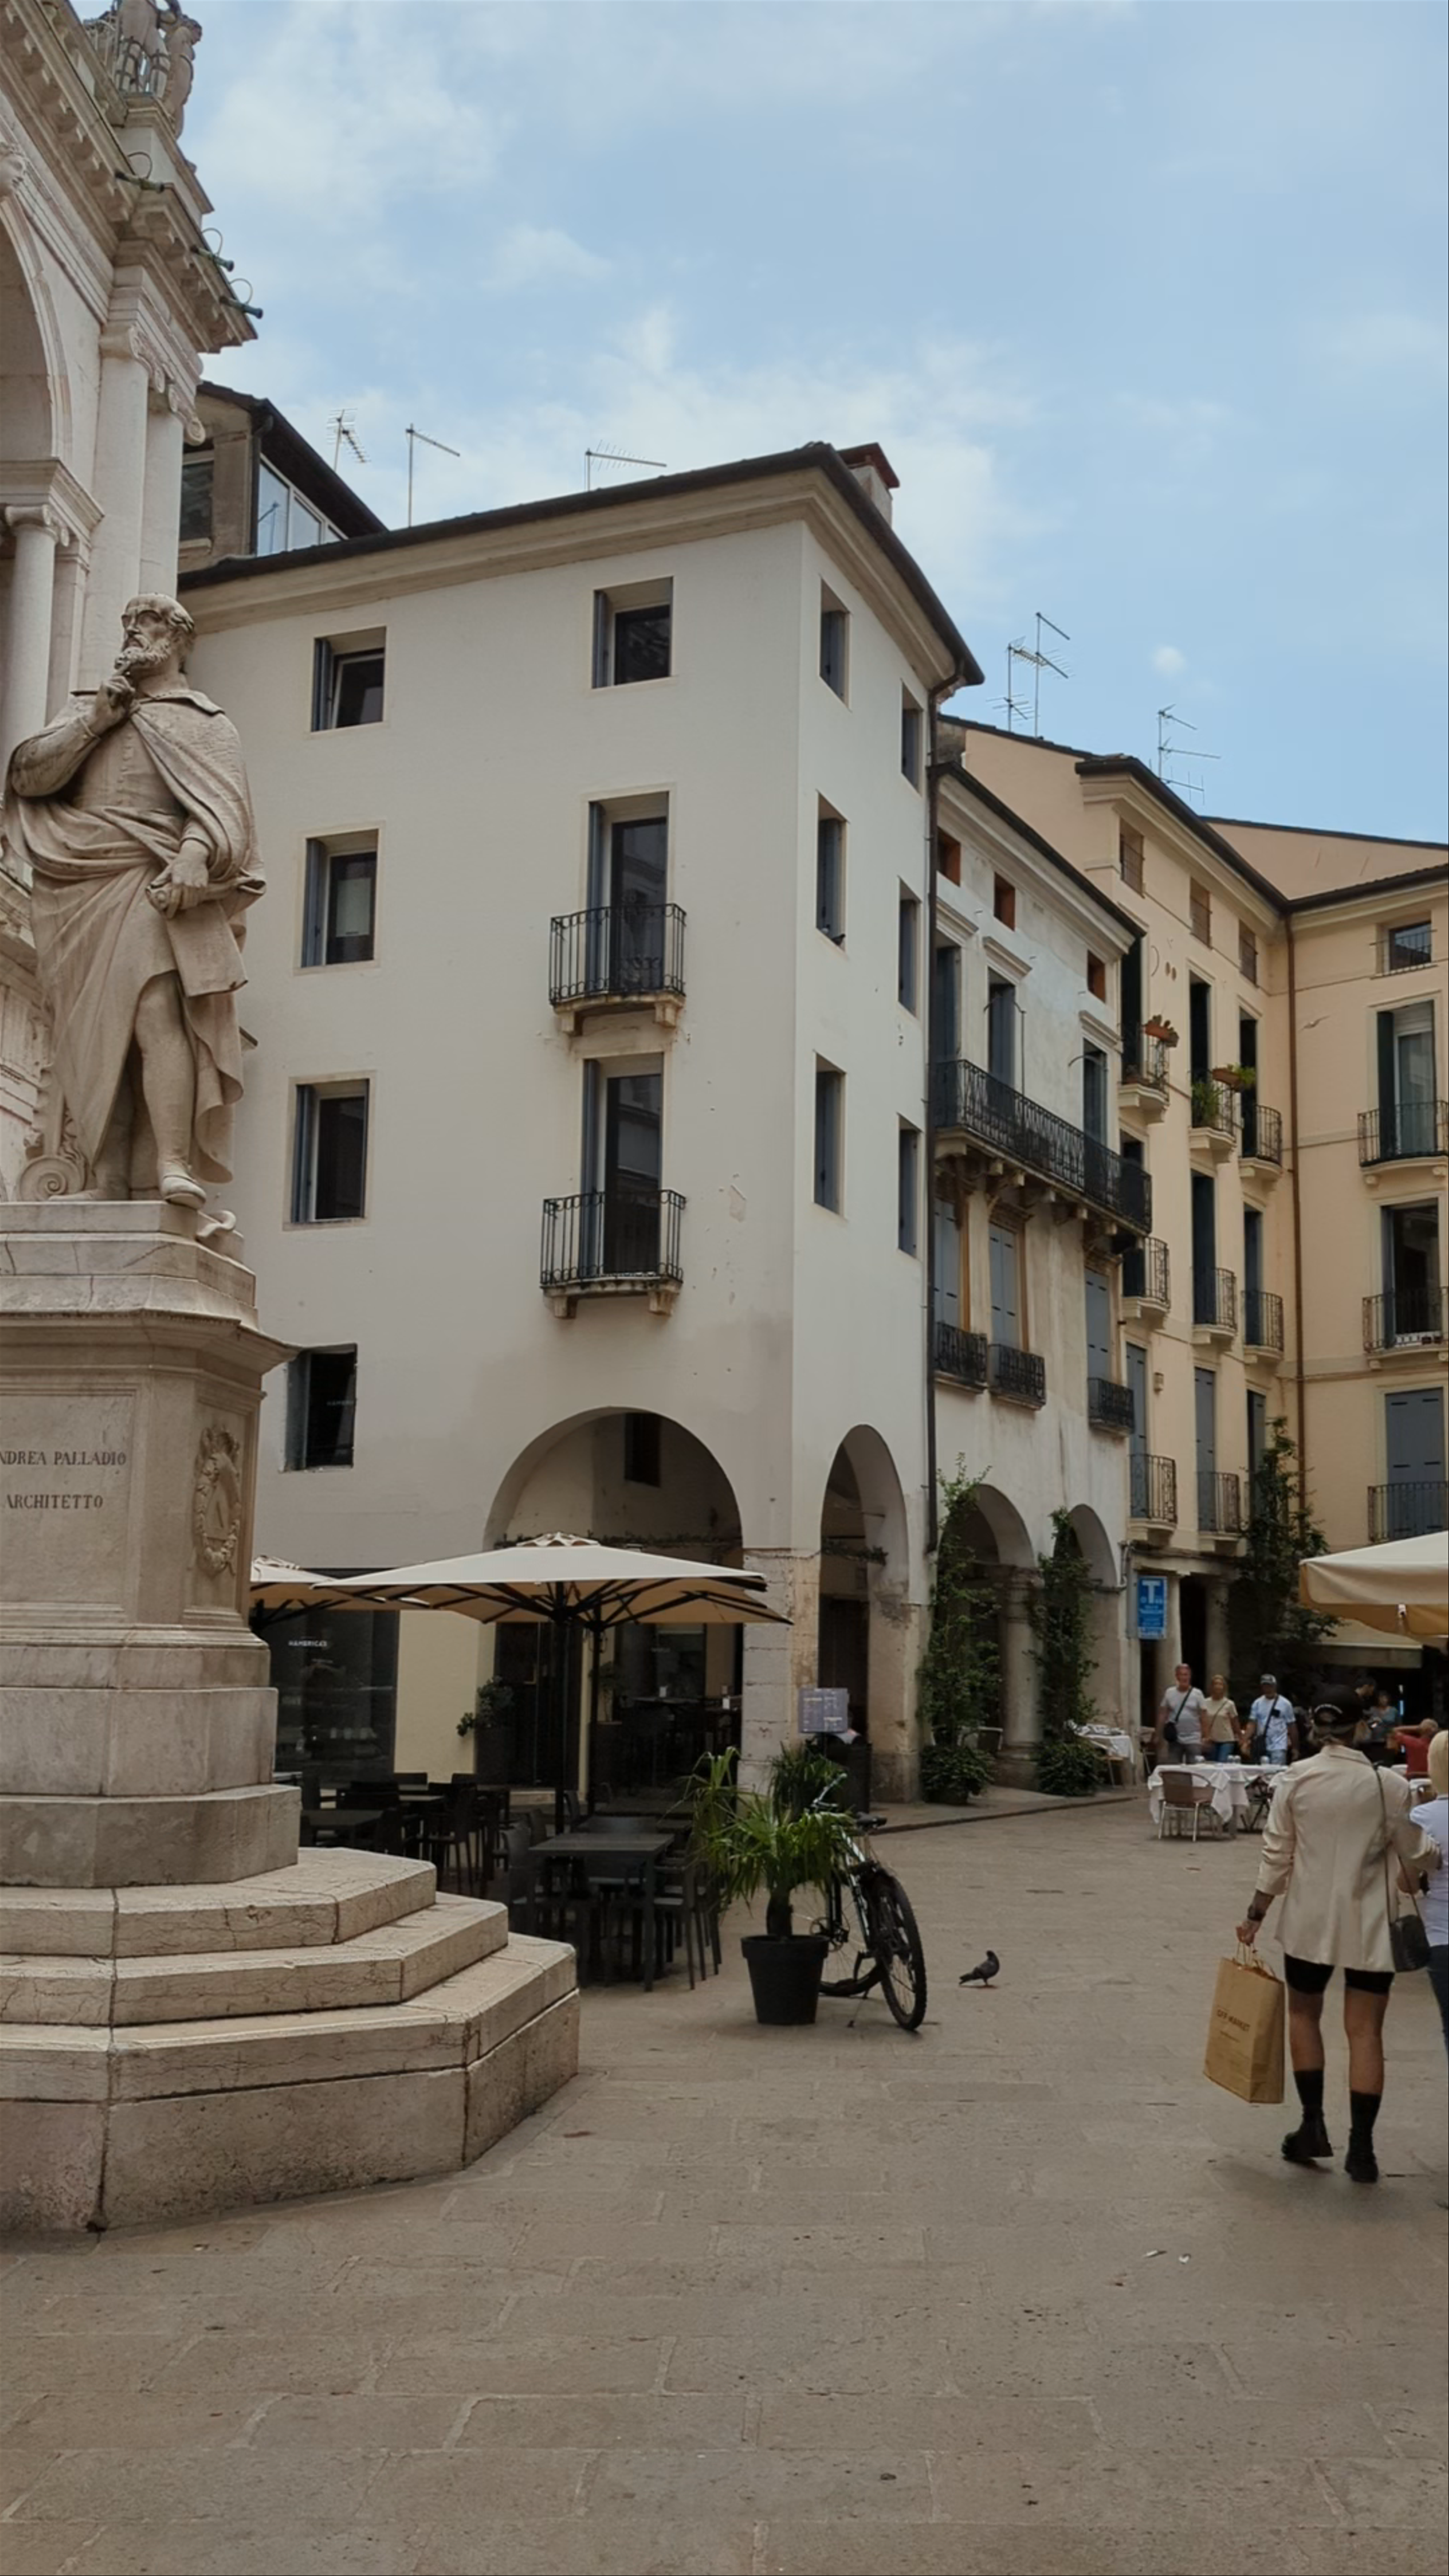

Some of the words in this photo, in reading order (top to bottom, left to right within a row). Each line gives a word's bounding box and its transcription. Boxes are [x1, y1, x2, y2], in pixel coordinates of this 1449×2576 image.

[54, 1451, 126, 1465] PALLADIO
[6, 1494, 103, 1509] ARCHITETTO
[1142, 1580, 1161, 1603] T
